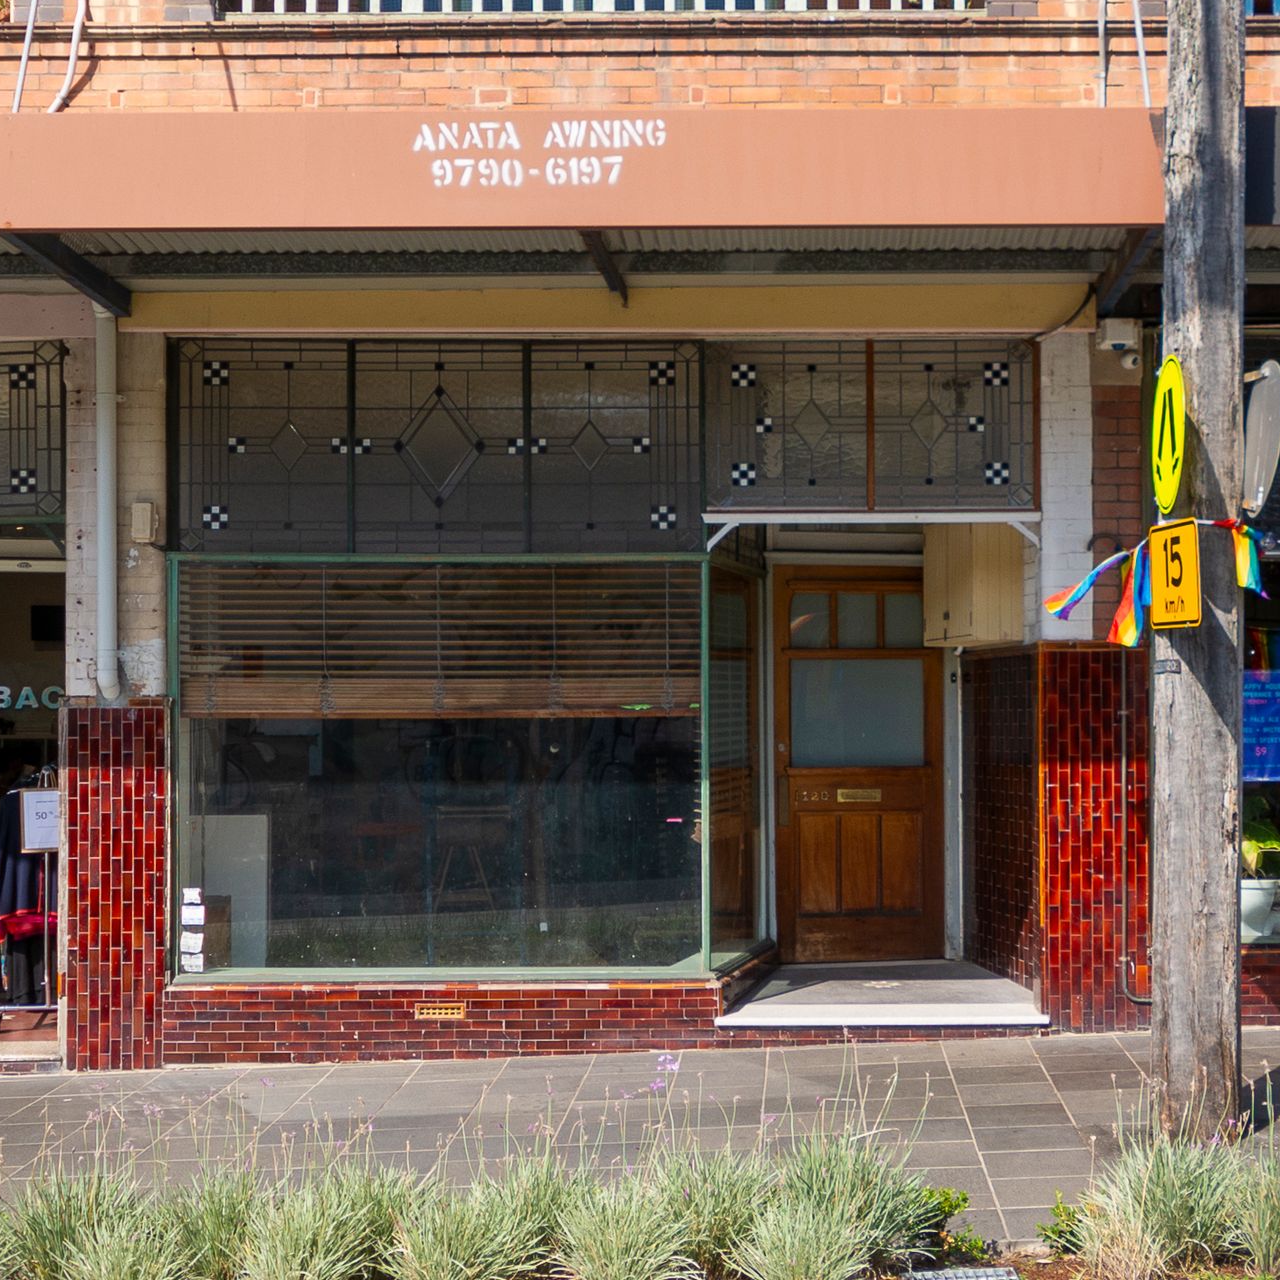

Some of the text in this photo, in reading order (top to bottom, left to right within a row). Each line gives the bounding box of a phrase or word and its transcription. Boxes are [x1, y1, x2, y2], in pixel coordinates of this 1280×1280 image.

[413, 119, 667, 151] ANATA AWNING
[431, 155, 623, 187] 9790-6197
[1163, 535, 1183, 588] 15
[1165, 595, 1186, 614] km/h
